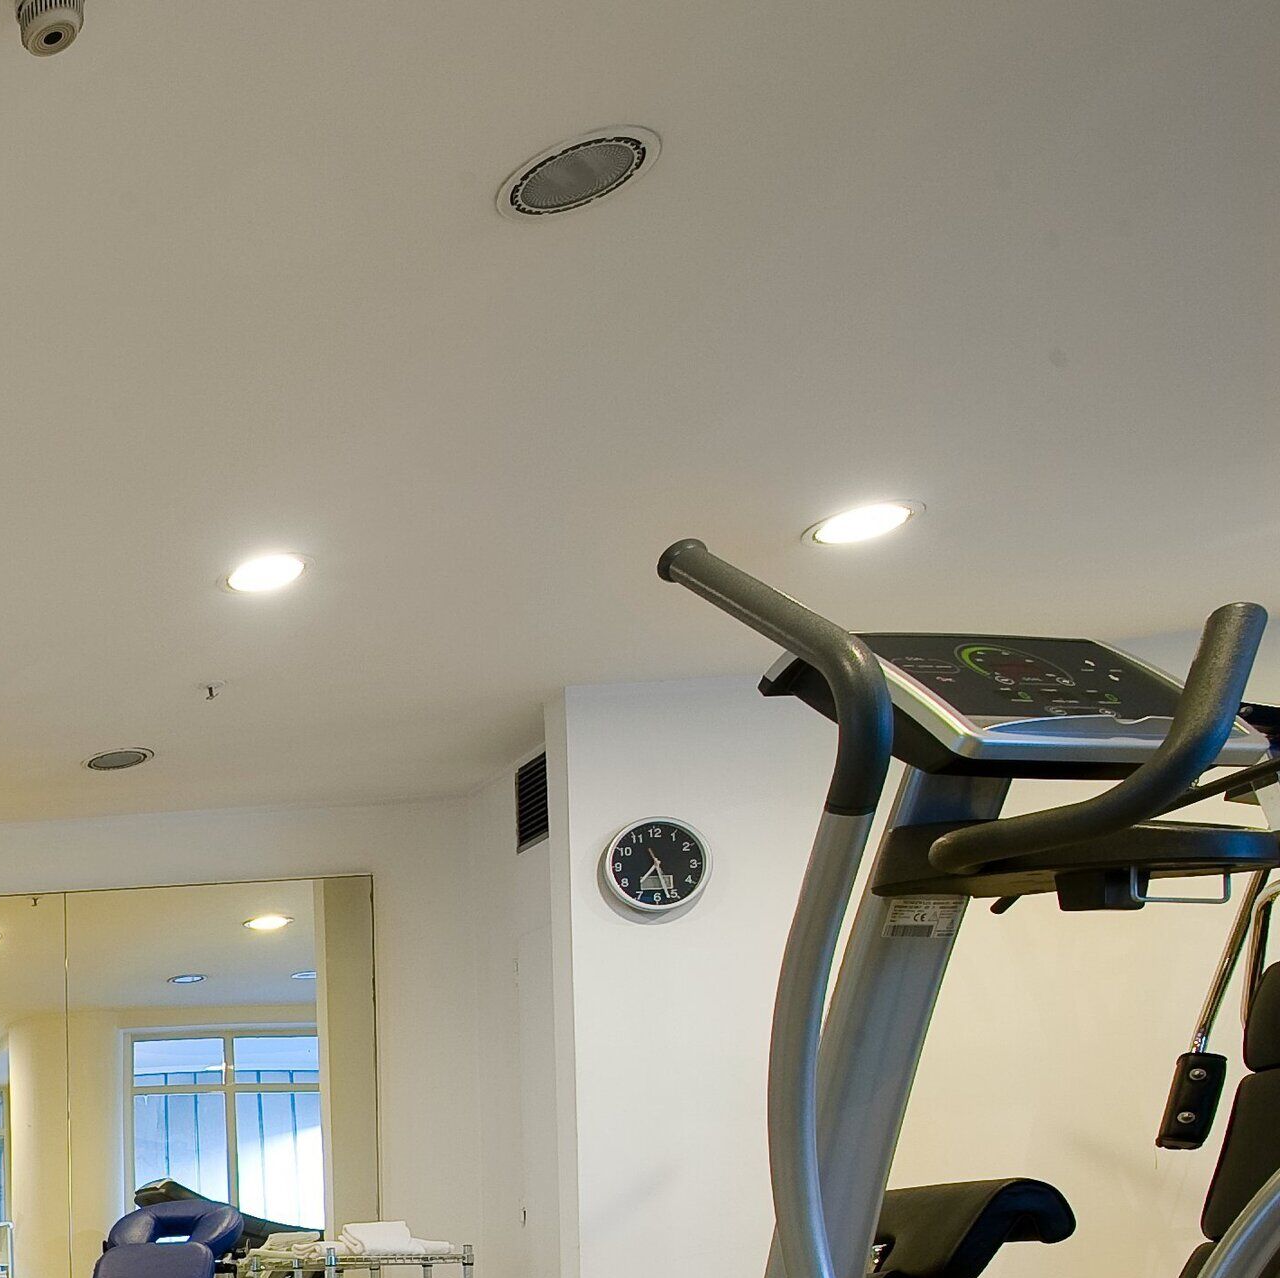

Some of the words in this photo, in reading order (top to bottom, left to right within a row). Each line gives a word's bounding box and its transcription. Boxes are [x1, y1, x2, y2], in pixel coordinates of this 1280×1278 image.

[648, 828, 662, 838] 12
[671, 833, 676, 841] 1
[632, 834, 643, 843] 11
[682, 842, 690, 851] 2
[620, 847, 632, 856] 10
[614, 862, 622, 872] 9
[690, 859, 698, 868] 3
[621, 878, 629, 887] 8
[685, 875, 693, 884] 4
[635, 891, 643, 900] 7
[653, 893, 661, 902] 6
[671, 889, 678, 898] 5
